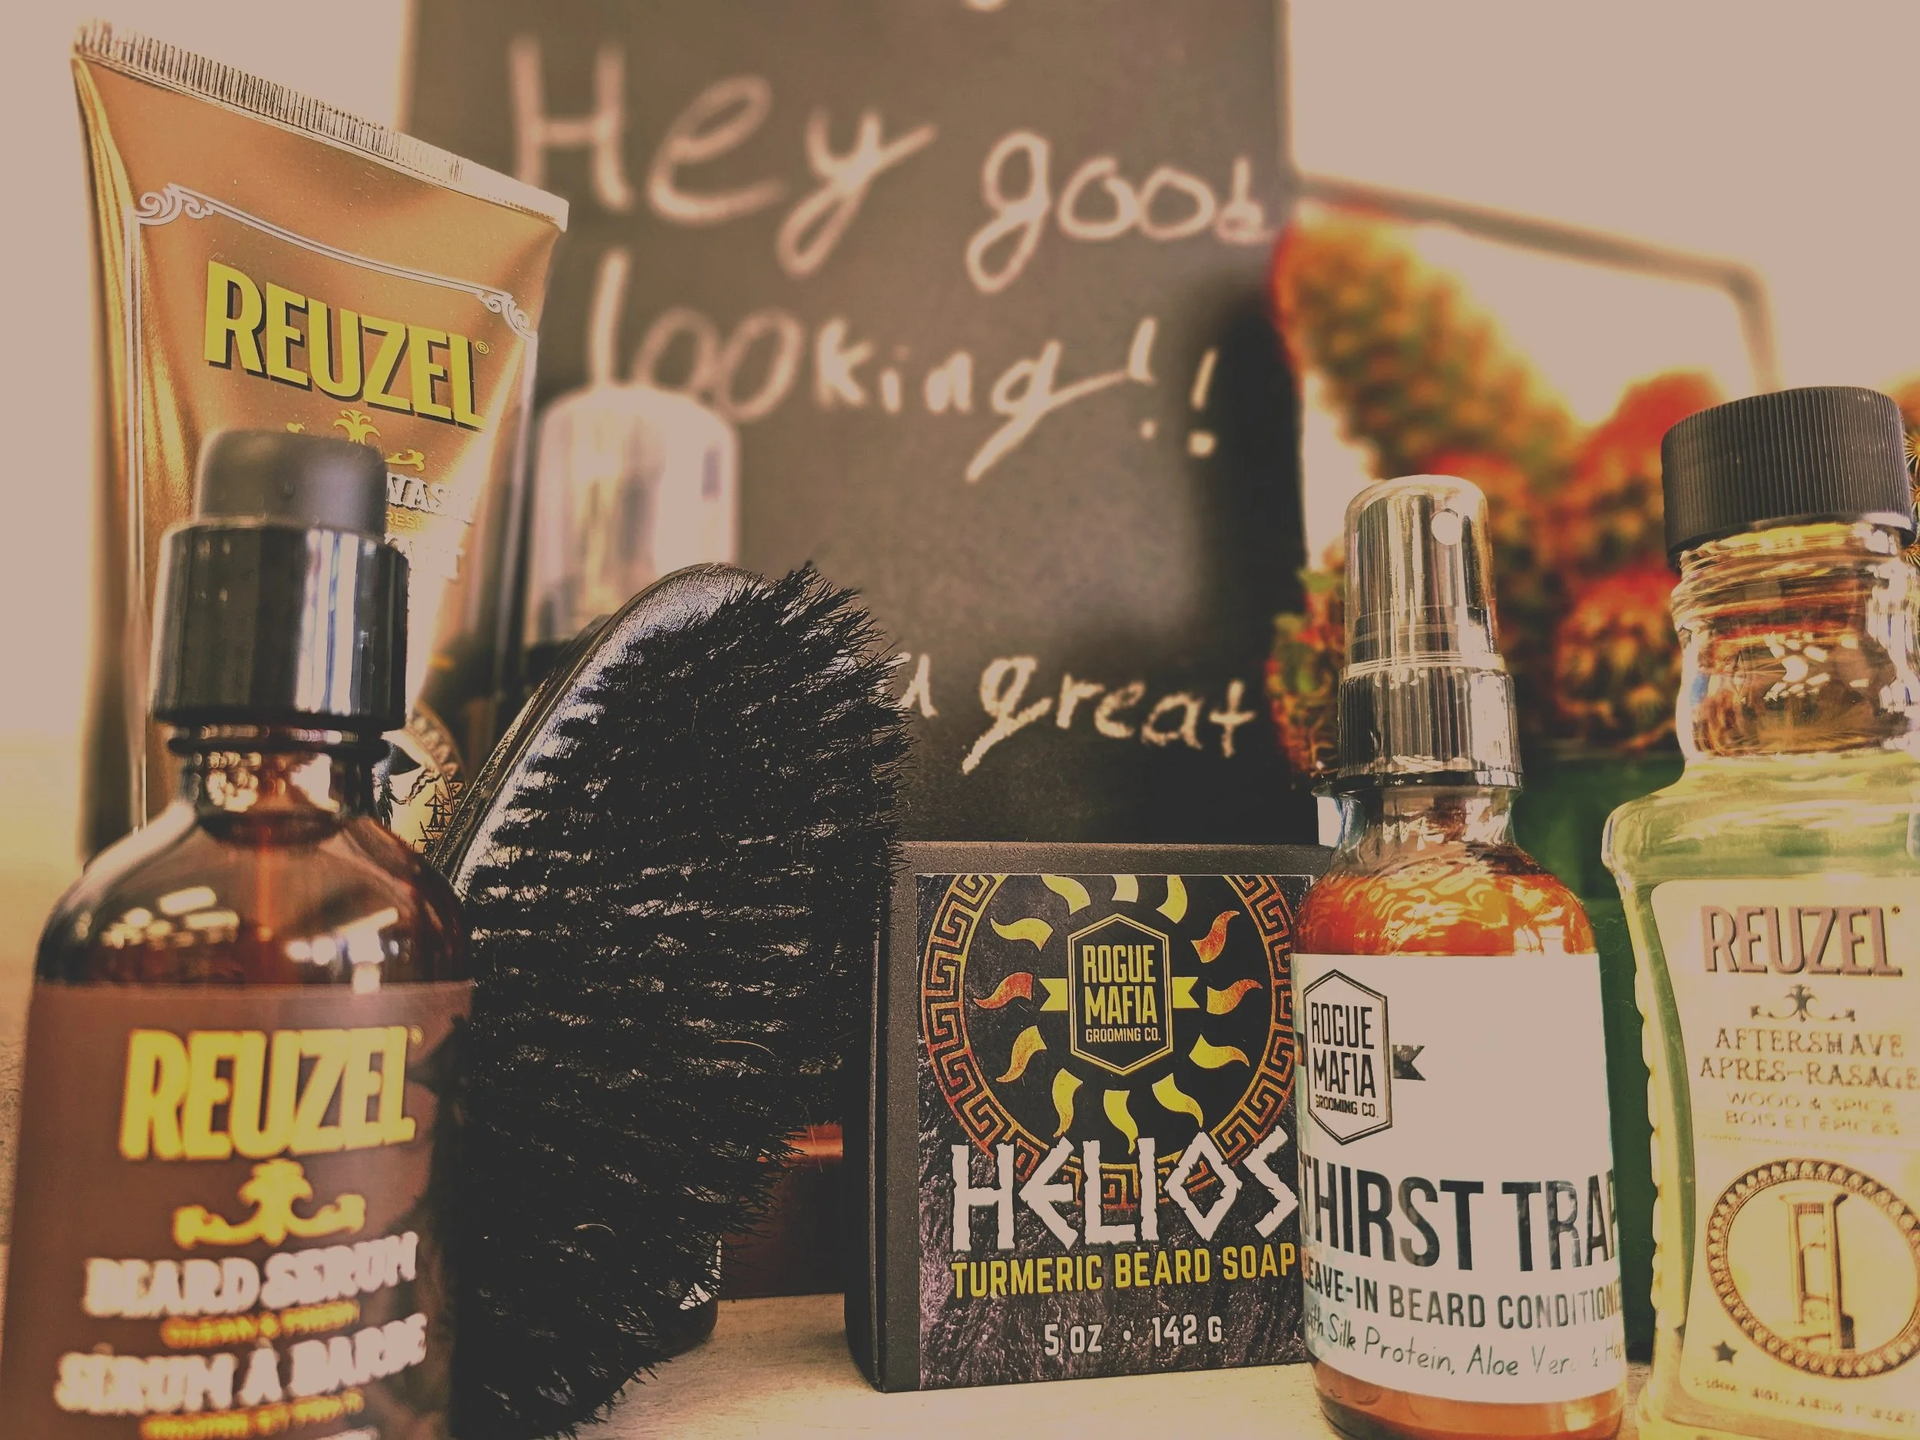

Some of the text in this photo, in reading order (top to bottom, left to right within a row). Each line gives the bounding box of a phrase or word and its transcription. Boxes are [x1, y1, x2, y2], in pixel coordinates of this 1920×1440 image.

[508, 38, 1278, 293] Hey good
[204, 259, 487, 432] REUZEL
[961, 655, 1256, 776] great
[1082, 944, 1157, 984] ROGUE
[1700, 905, 1904, 977] REUZEL
[1084, 985, 1158, 1026] MAFIA
[1311, 1001, 1375, 1050] ROGUE
[1085, 1026, 1162, 1043] GROOMING CO.
[1716, 1026, 1904, 1059] AFTERSHAVE
[121, 1026, 416, 1160] REUZEL
[1313, 1047, 1377, 1099] MAFIA
[1315, 1093, 1380, 1118] GROOMING CO.
[1726, 1091, 1801, 1109] WOOD
[951, 1125, 1299, 1251] HELIOS
[1298, 1151, 1485, 1272] THIRST
[951, 1242, 1296, 1299] TURMERIC BEARD SOAP
[1389, 1284, 1486, 1328] BEARD
[1044, 1314, 1222, 1356] 5 OZ 142 G
[1328, 1313, 1357, 1351] Silk
[1364, 1325, 1456, 1376] Protein,
[1466, 1343, 1519, 1376] Aloe
